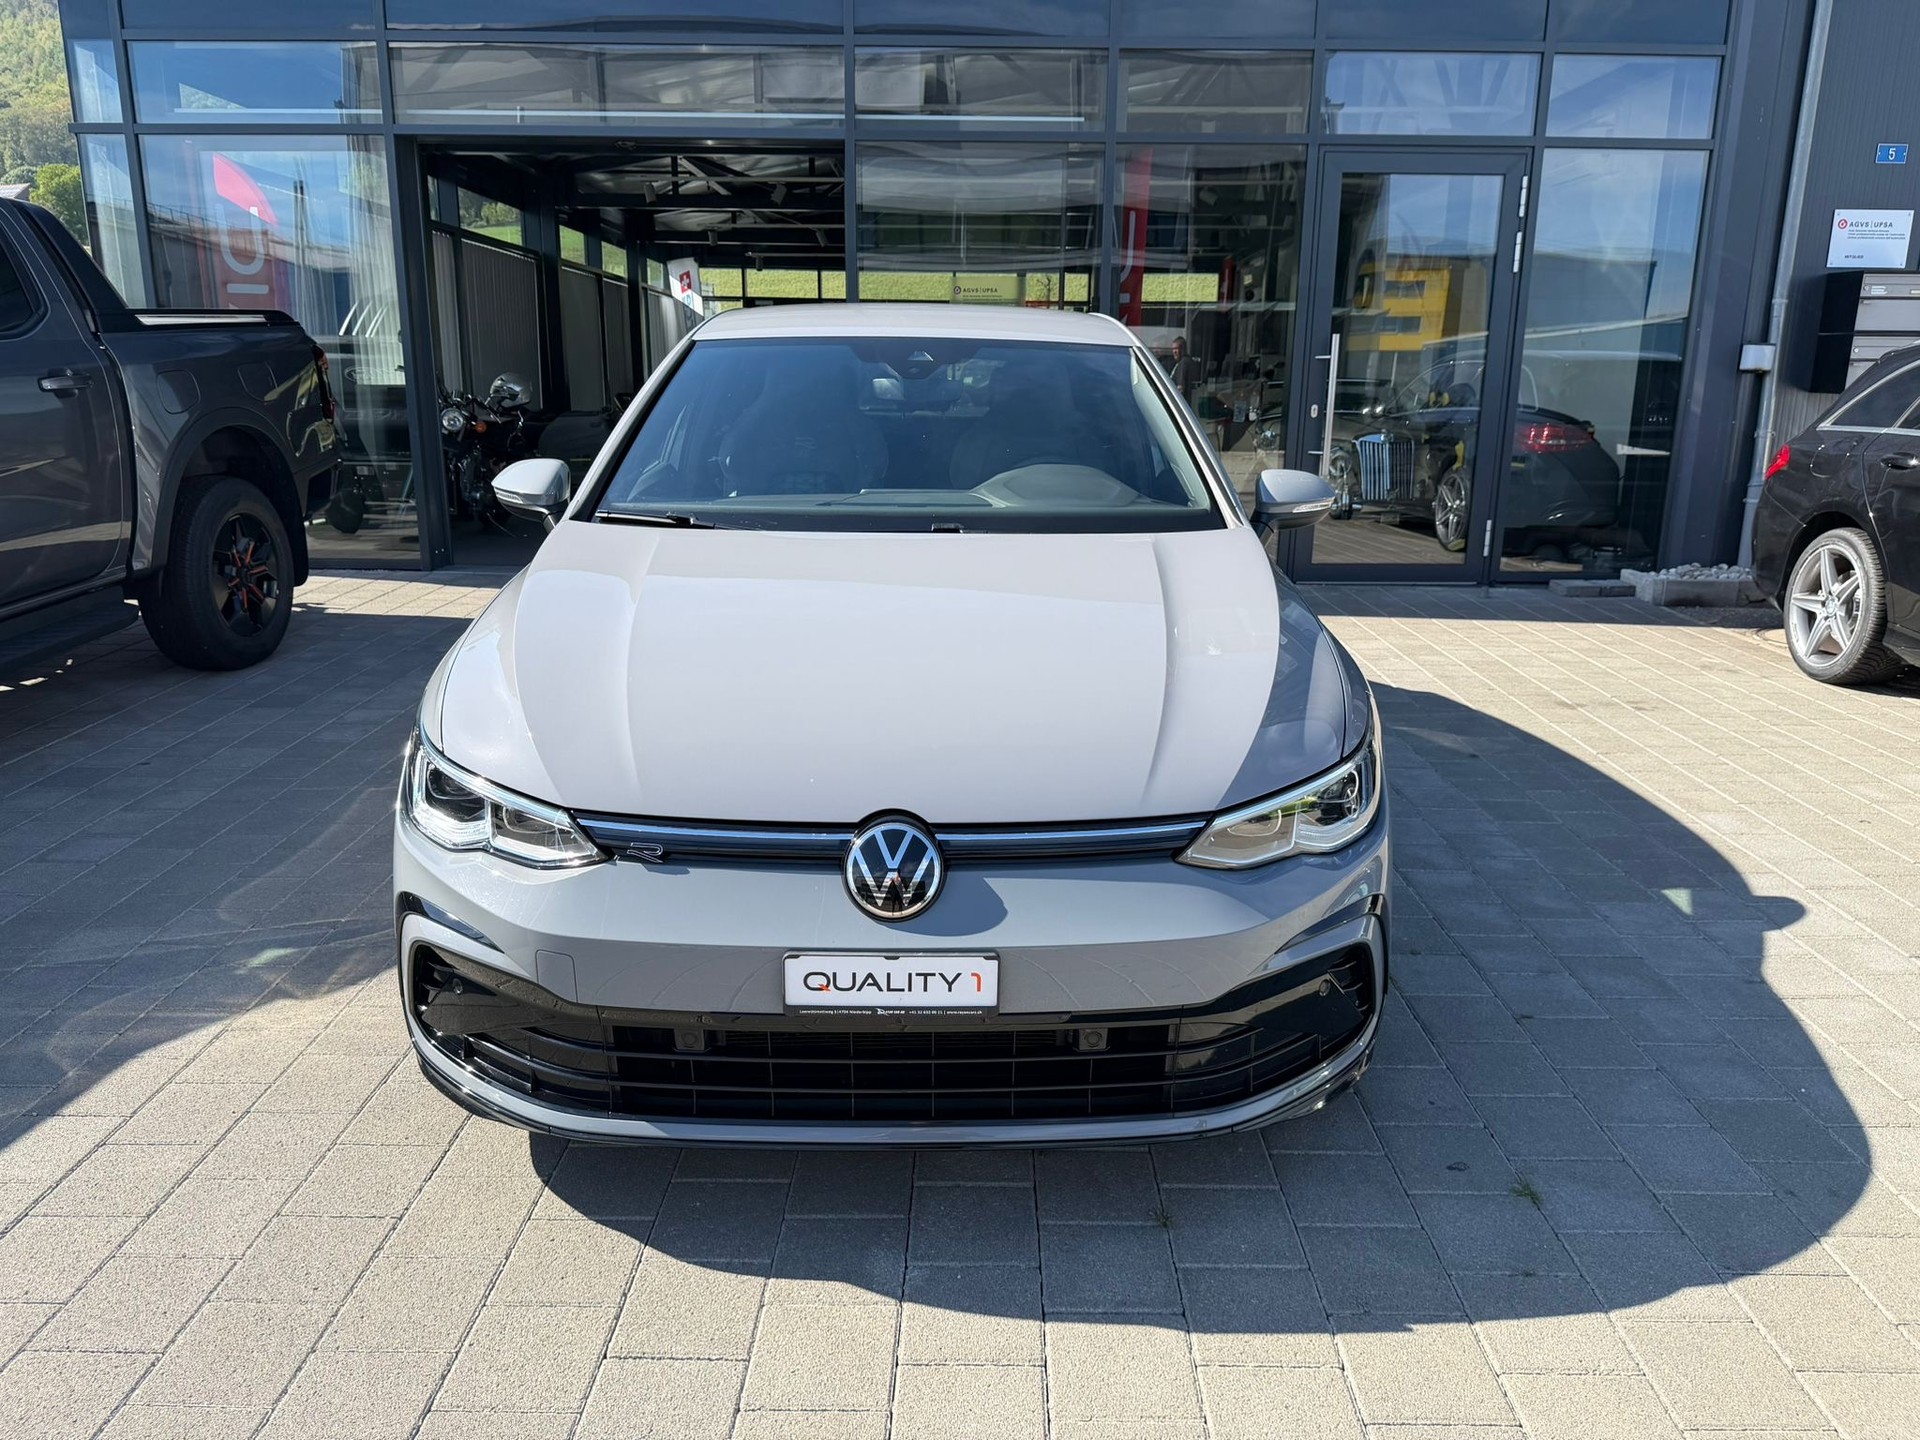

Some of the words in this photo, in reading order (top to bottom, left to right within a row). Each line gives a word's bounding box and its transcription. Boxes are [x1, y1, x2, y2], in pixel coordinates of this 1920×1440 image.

[1888, 147, 1896, 161] 5
[1849, 220, 1870, 228] AGVS
[1873, 220, 1893, 228] UPSA
[803, 971, 962, 993] QUALITY
[970, 972, 982, 992] 1
